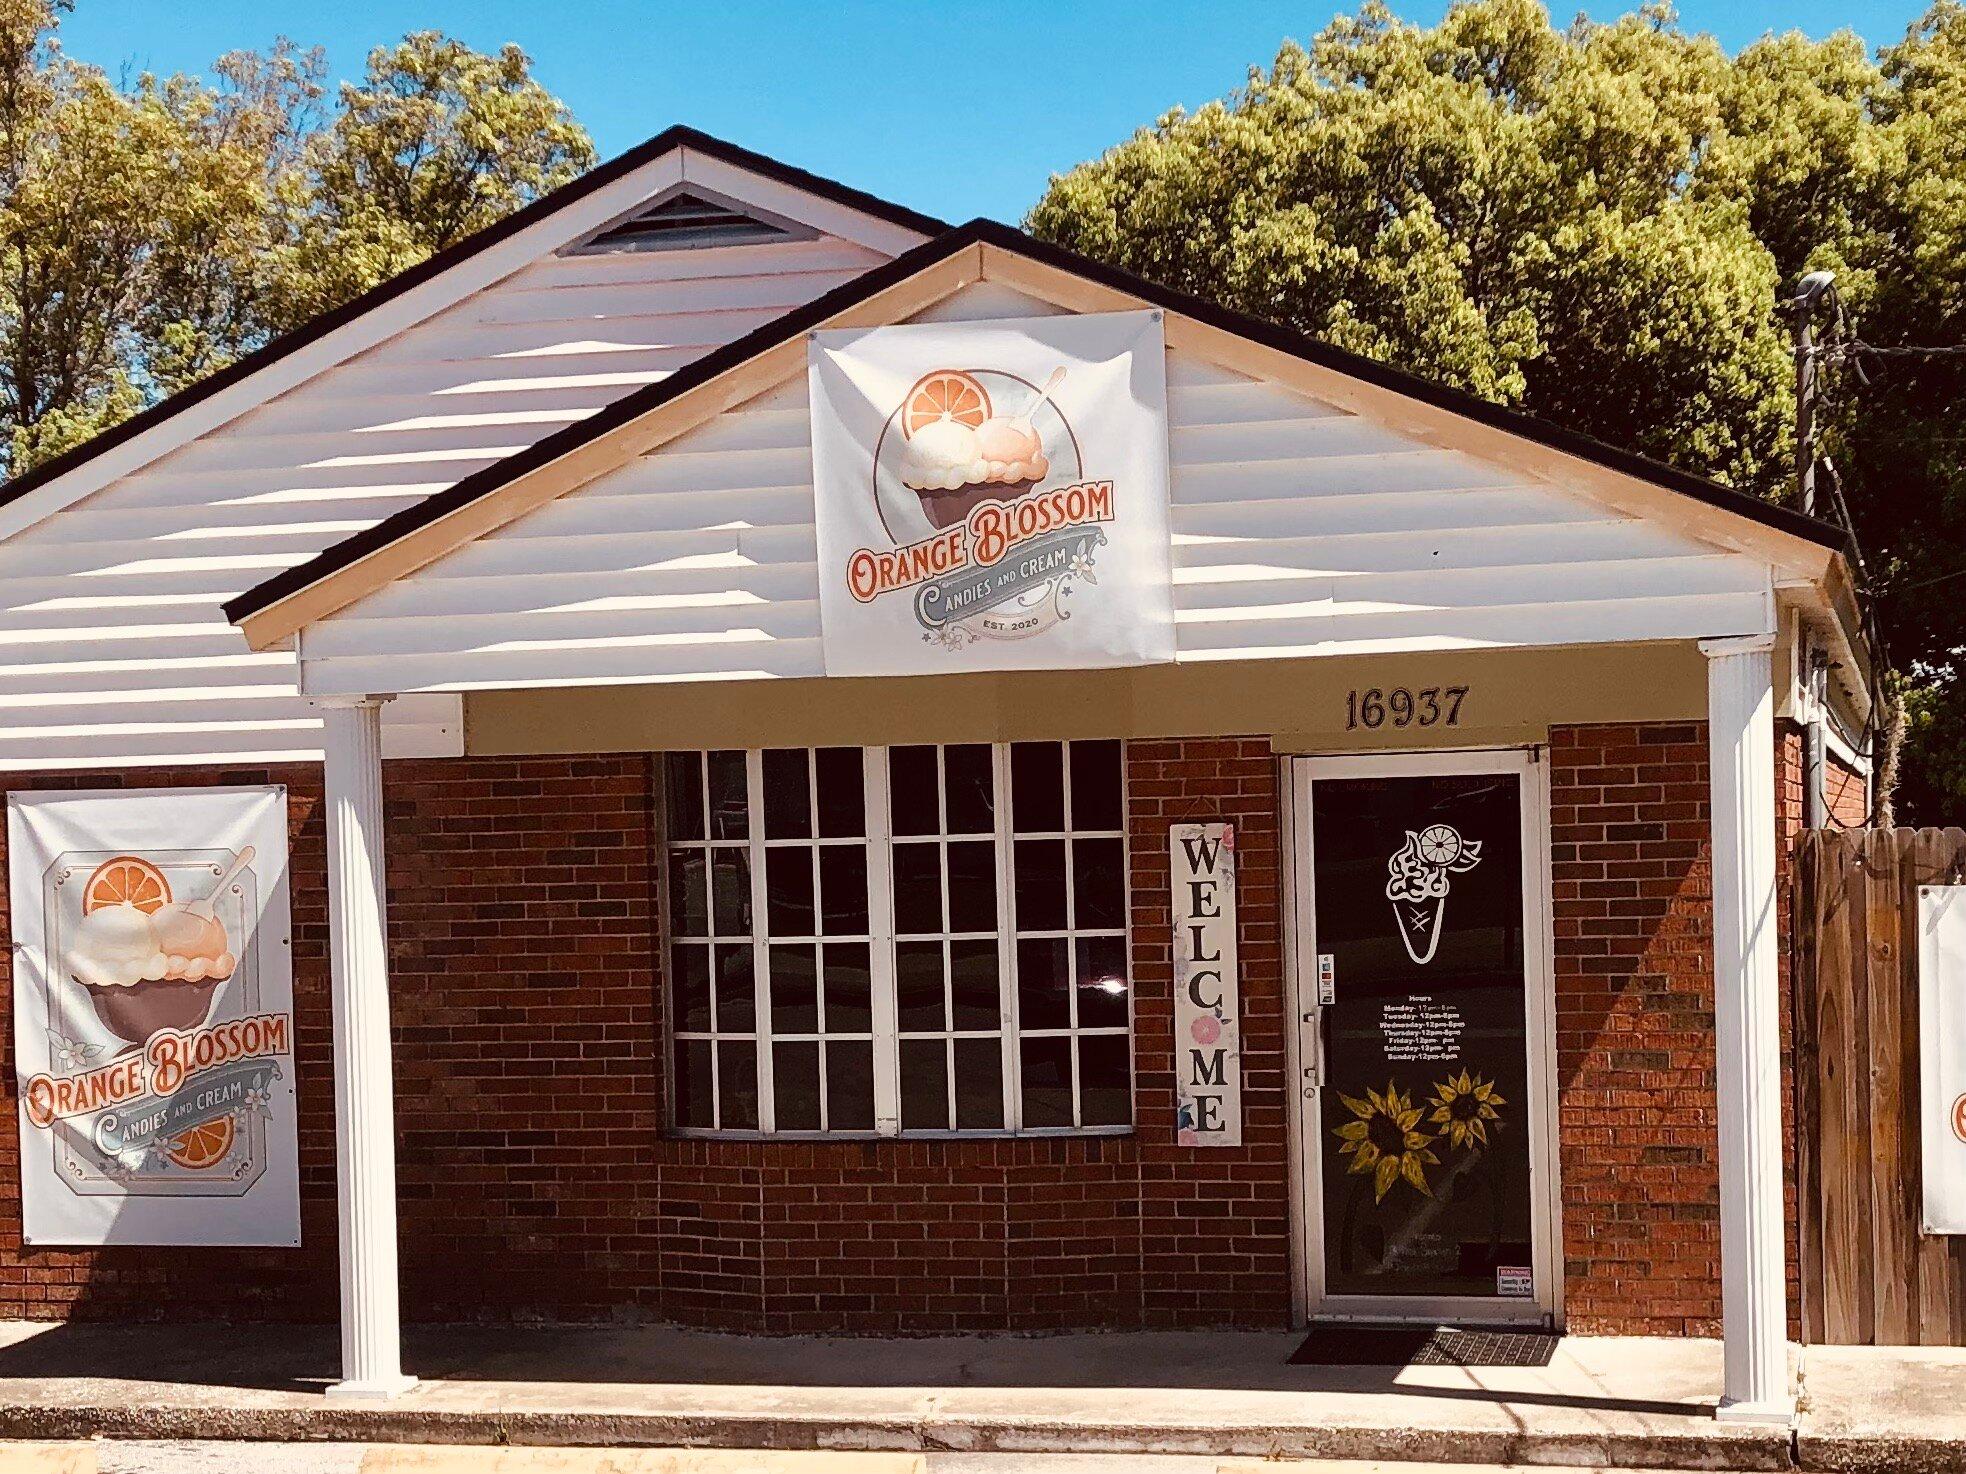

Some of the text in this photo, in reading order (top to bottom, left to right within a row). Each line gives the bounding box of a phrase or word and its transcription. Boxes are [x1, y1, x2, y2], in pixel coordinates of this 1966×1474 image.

[851, 485, 1109, 598] ORANGE BLOSSOM
[918, 549, 1066, 626] CANDIES AND CREAM
[1011, 617, 1039, 631] 2020
[1346, 685, 1470, 731] 16937
[1180, 837, 1229, 1132] WELCME
[1408, 994, 1432, 1002] Hours
[27, 1018, 285, 1125] ORANGE BLOSSOM
[95, 1081, 243, 1156] CANDIES AND CREAM
